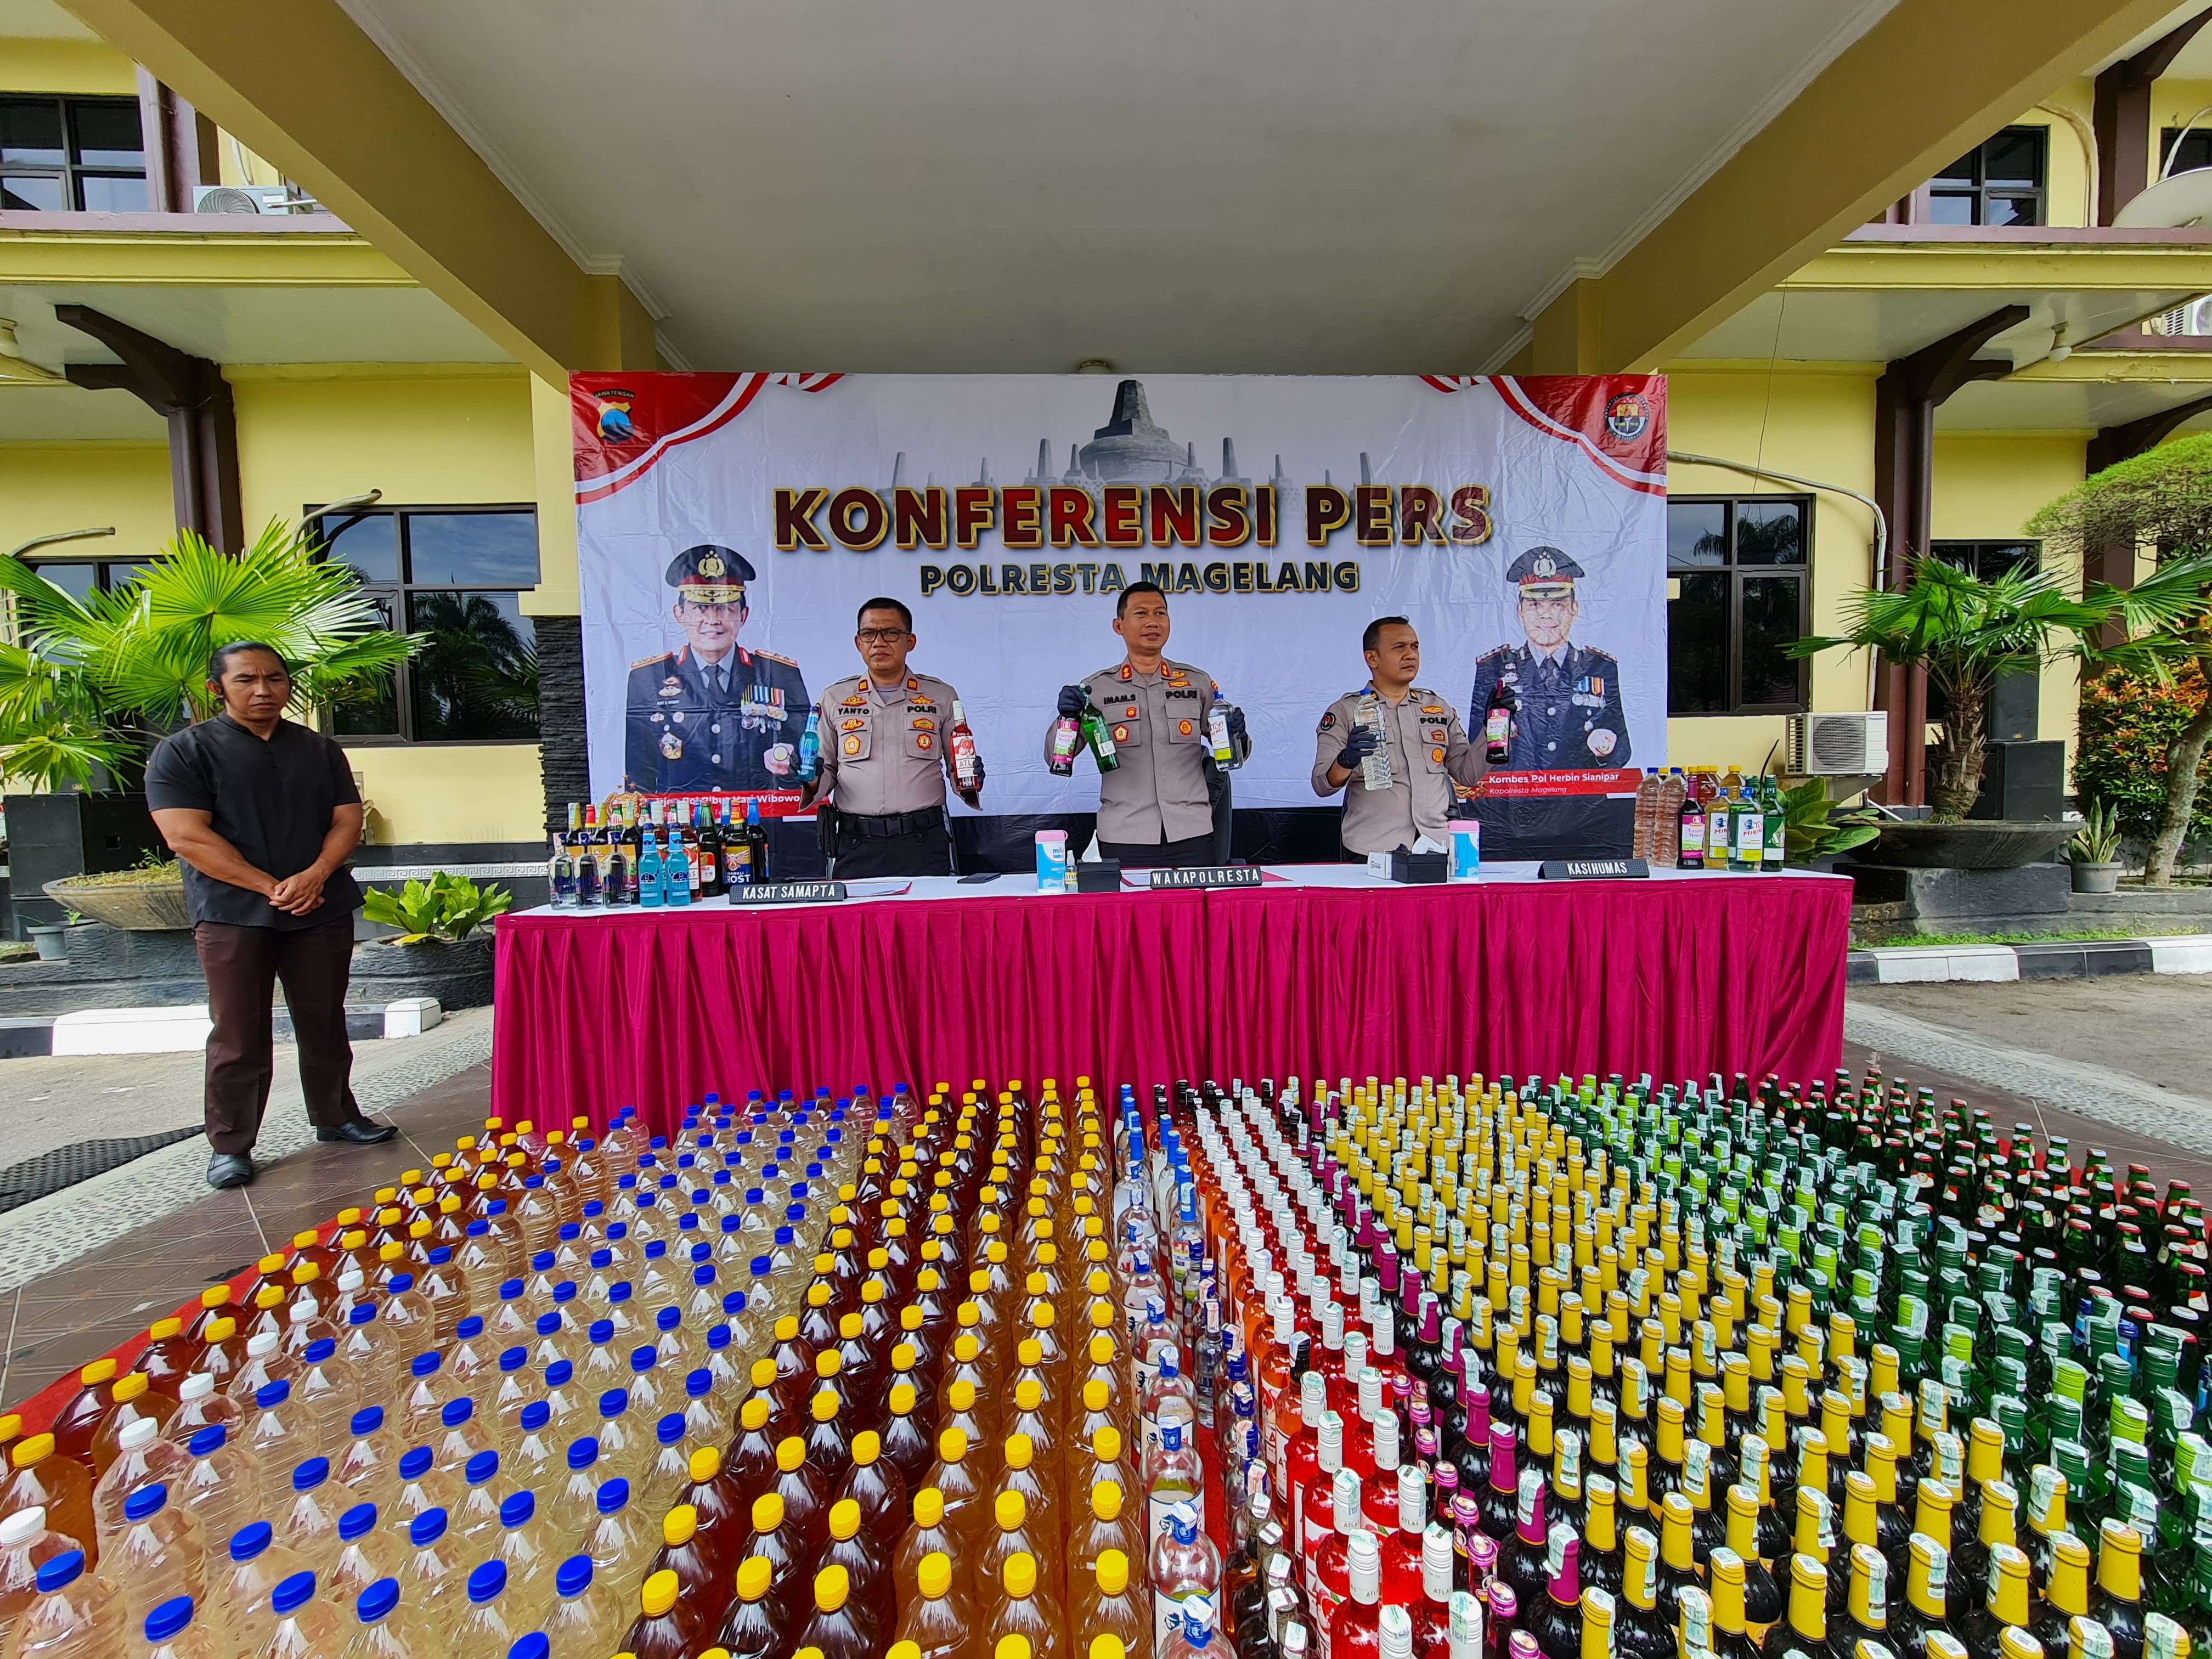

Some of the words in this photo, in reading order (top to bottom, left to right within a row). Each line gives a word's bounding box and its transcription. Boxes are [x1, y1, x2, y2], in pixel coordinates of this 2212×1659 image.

[773, 486, 1277, 551] KONFERENSI
[1305, 485, 1492, 546] PERS
[919, 562, 1127, 596] POLRESTA
[1140, 561, 1359, 594] MAGELANG
[1165, 690, 1197, 699] POLRI
[907, 706, 937, 714] POLRI
[1489, 775, 1529, 784] Kombes
[1549, 774, 1580, 782] Herbin
[1582, 772, 1620, 782] Sianipar
[757, 794, 800, 803] Wibowo
[1567, 862, 1628, 875] KASIHUMAS
[727, 874, 751, 883] ROST
[1153, 869, 1259, 884] WAKAPOLRESTA
[742, 886, 777, 899] KASAT
[781, 884, 835, 898] SAMAPTA
